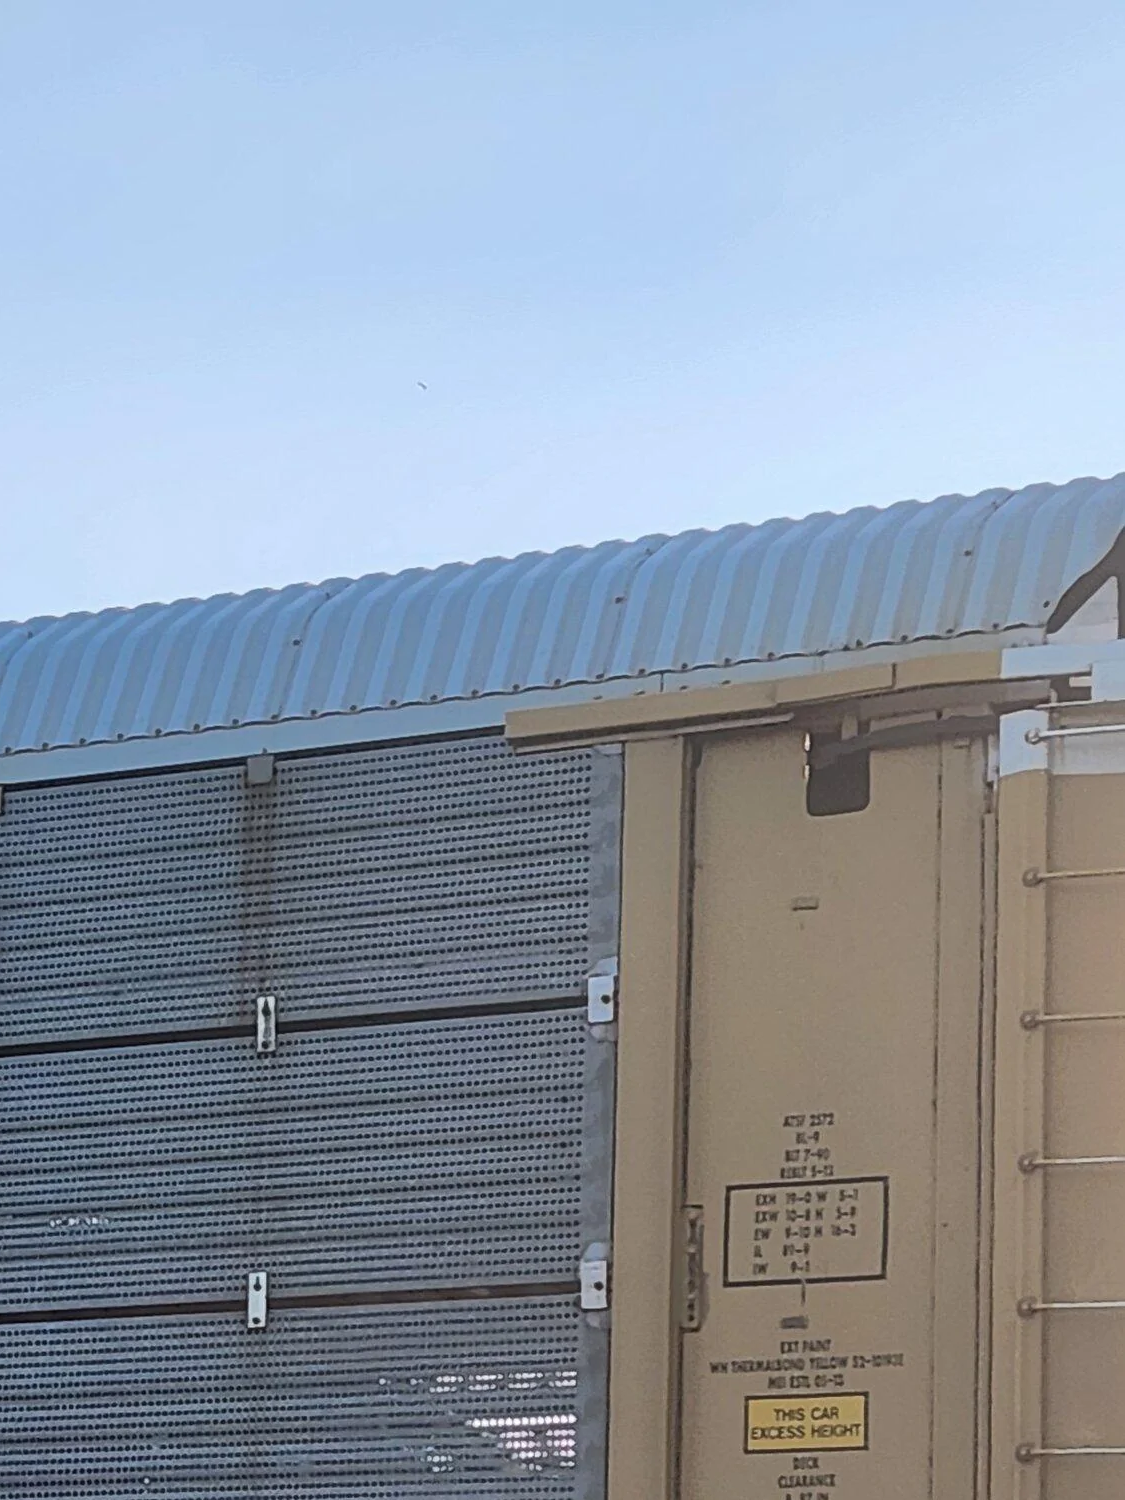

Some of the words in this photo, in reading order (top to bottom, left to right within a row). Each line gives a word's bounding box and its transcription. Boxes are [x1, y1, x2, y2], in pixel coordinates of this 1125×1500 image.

[809, 1356, 849, 1369] YELLOW
[773, 1407, 806, 1422] THIS
[810, 1406, 840, 1420] CAR
[751, 1425, 806, 1440] EXCESS
[810, 1423, 862, 1438] HEIGHT
[778, 1474, 836, 1488] CLEARANCE
